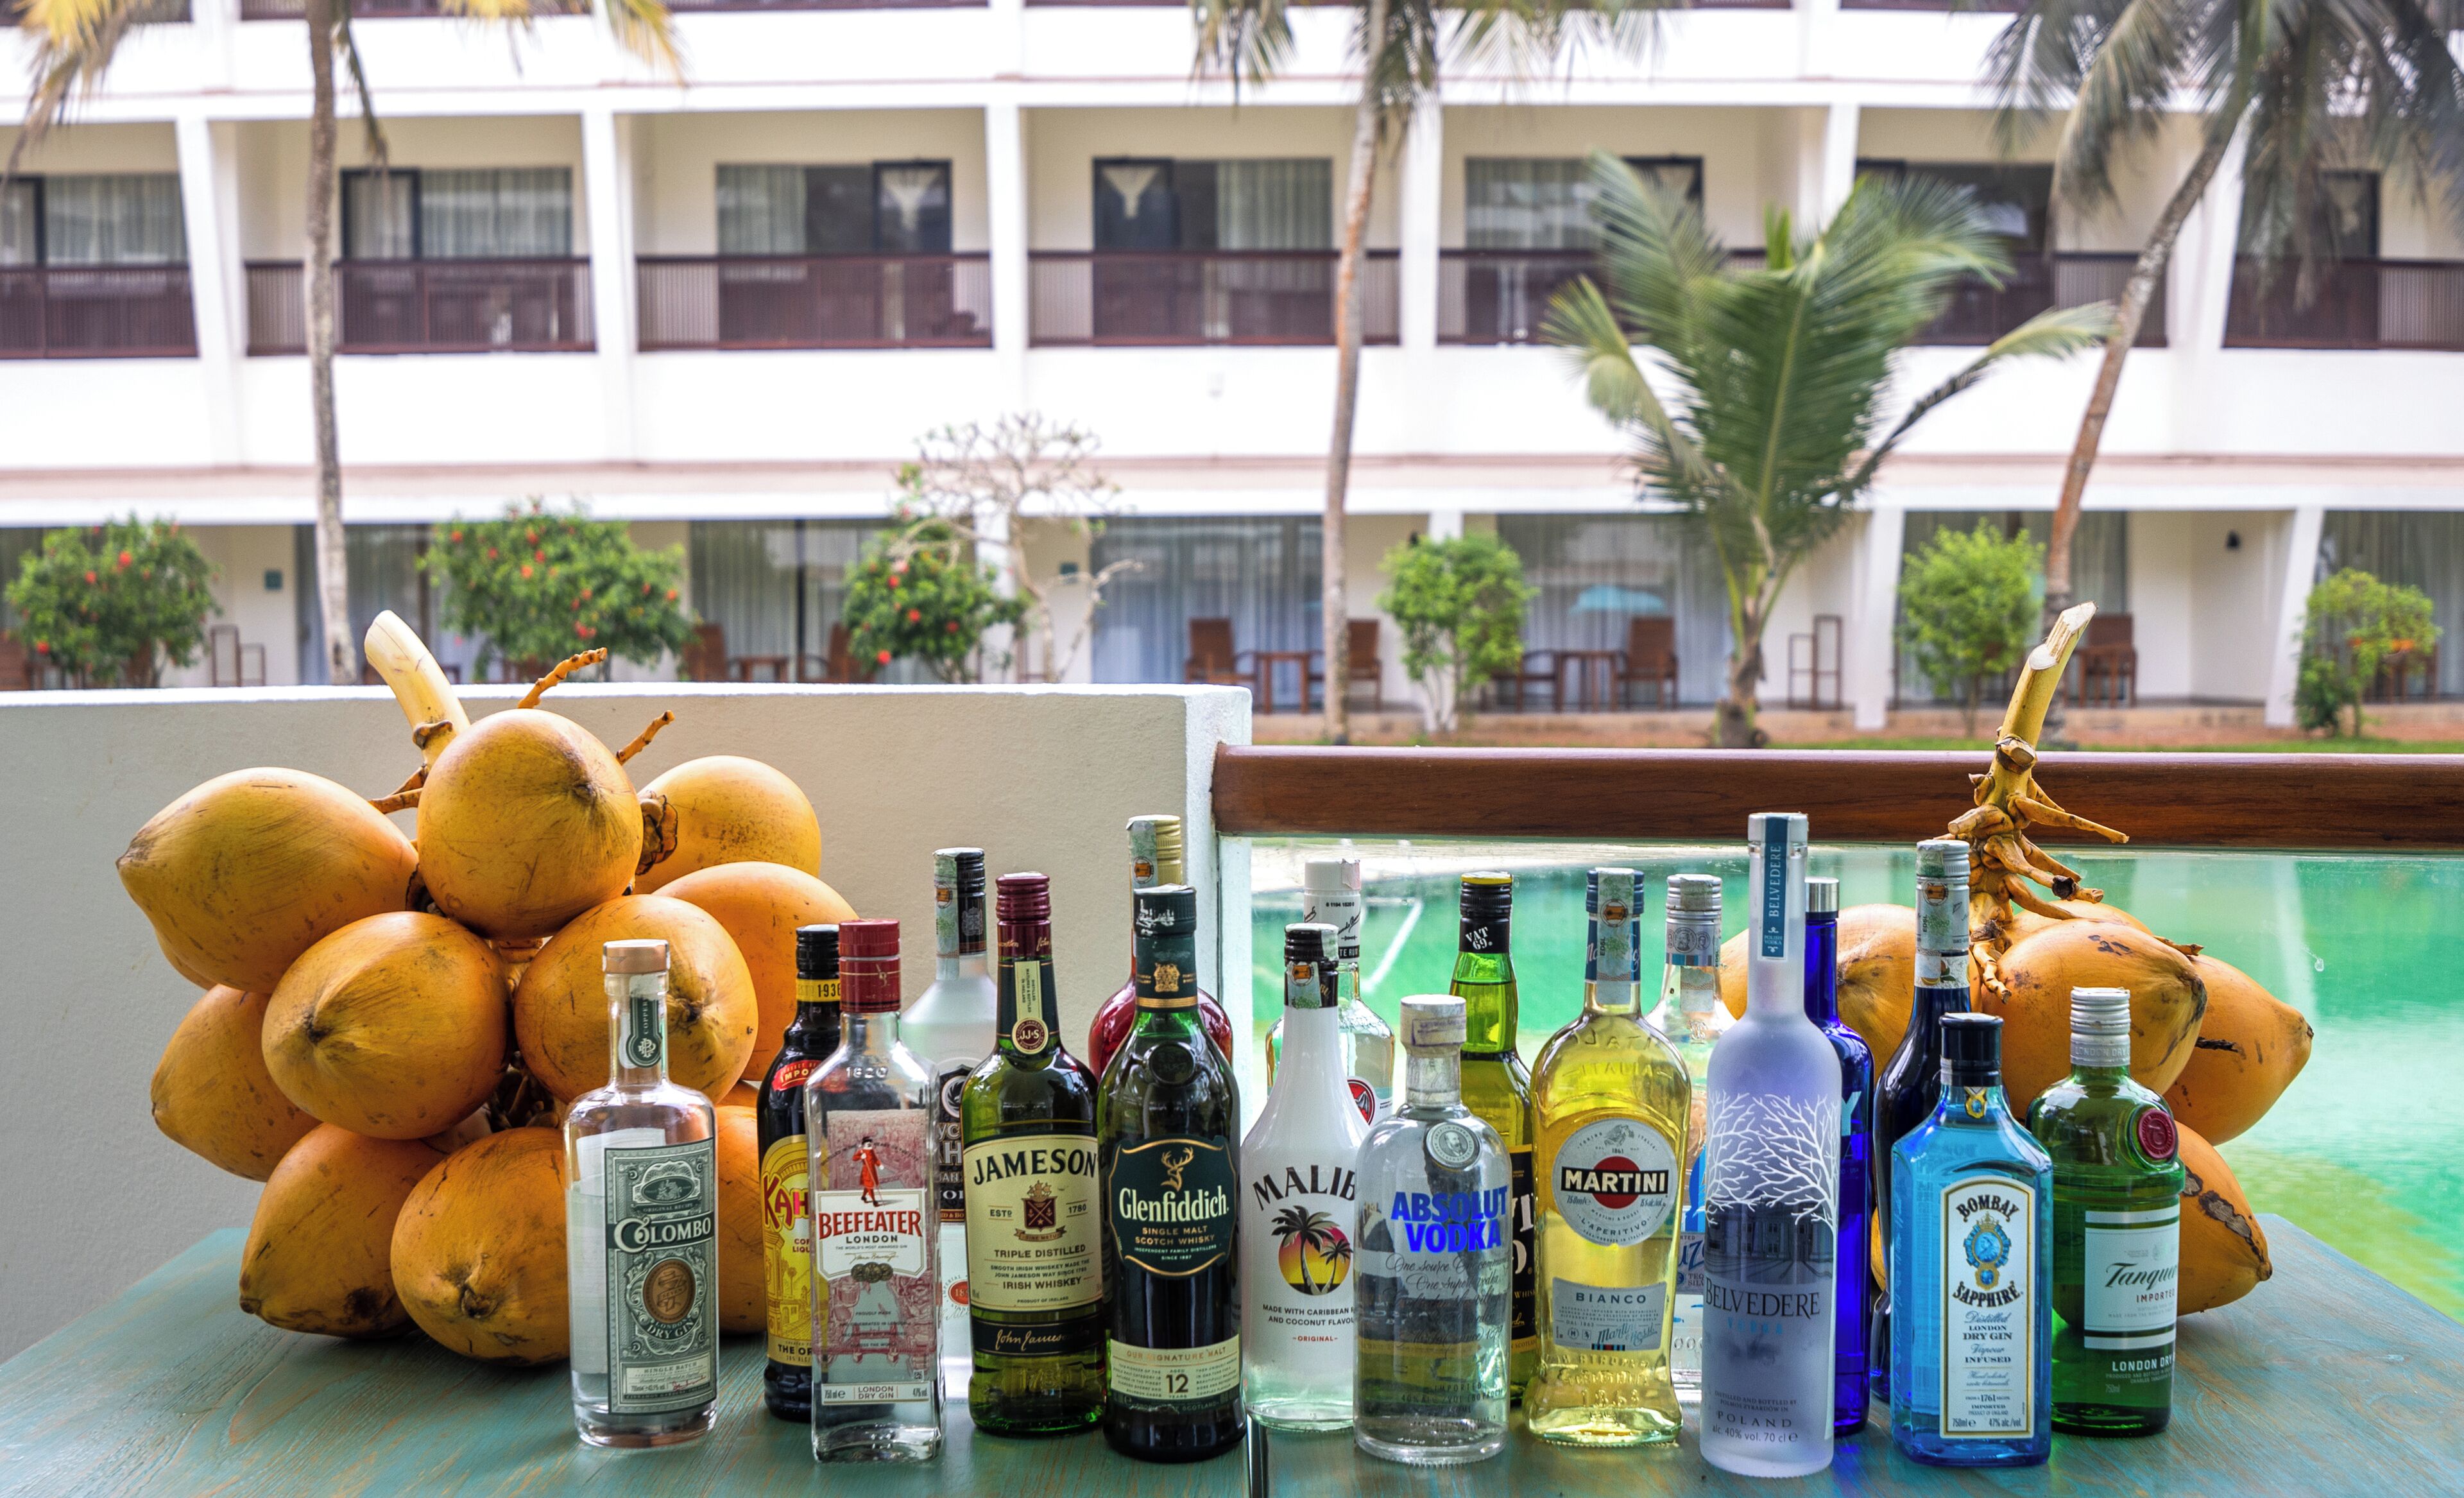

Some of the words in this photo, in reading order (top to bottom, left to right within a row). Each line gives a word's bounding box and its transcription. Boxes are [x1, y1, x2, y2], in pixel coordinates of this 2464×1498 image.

[1769, 846, 1781, 917] BELVEDERE
[1466, 926, 1488, 943] VAT
[2076, 1046, 2109, 1056] LONDON
[2112, 1047, 2126, 1056] DRY
[846, 1066, 889, 1078] 1820
[973, 1149, 1097, 1185] JAMESON
[1253, 1165, 1355, 1211] MALIB
[1565, 1169, 1666, 1193] MARTINI
[764, 1174, 809, 1230] KAH
[1068, 1203, 1087, 1214] 1780
[1119, 1185, 1227, 1222] Glenfiddich
[1391, 1185, 1508, 1222] ABSOLUT
[1955, 1194, 2020, 1222] BOMBAY
[819, 1210, 923, 1240] BEEFEATER
[1142, 1227, 1179, 1235] SINGLE
[1183, 1225, 1208, 1234] MALT
[614, 1217, 711, 1252] COLOMBO
[846, 1235, 898, 1244] LONDON
[1135, 1236, 1174, 1245] SCOTCH
[1178, 1234, 1215, 1244] WHISKY
[1405, 1219, 1502, 1253] VODKA
[995, 1249, 1031, 1258] TRIPLE
[1035, 1244, 1086, 1257] DISTILLED
[1416, 1261, 1450, 1275] source
[1003, 1280, 1032, 1289] IRISH
[1034, 1276, 1082, 1289] WHISKEY
[1576, 1293, 1647, 1304] BIANCO
[1706, 1277, 1820, 1320] BELVEDERE
[1952, 1280, 2021, 1307] SAPPHIRE
[1263, 1304, 1282, 1313] MADE
[1307, 1307, 1349, 1316] CARIBBEAN
[647, 1324, 671, 1339] DRY
[675, 1318, 695, 1337] GIN
[655, 1320, 686, 1328] LONDON
[1285, 1318, 1326, 1326] COCONUT
[995, 1329, 1022, 1350] John
[778, 1345, 795, 1354] THE
[1127, 1350, 1143, 1359] OUR
[1147, 1352, 1204, 1361] SIGNATURE
[1208, 1347, 1226, 1358] MALT
[676, 1361, 697, 1370] BATCH
[2112, 1358, 2157, 1372] LONDON
[2160, 1354, 2172, 1367] DRY
[1166, 1374, 1188, 1393] 12
[1715, 1391, 1741, 1402] DISTILLED
[1182, 1402, 1216, 1411] SCOTLAND
[1717, 1410, 1792, 1428] POLAND
[1725, 1427, 1742, 1440] 40%
[1744, 1432, 1761, 1442] vol.
[1764, 1432, 1775, 1442] 70
[1778, 1433, 1786, 1443] cl
